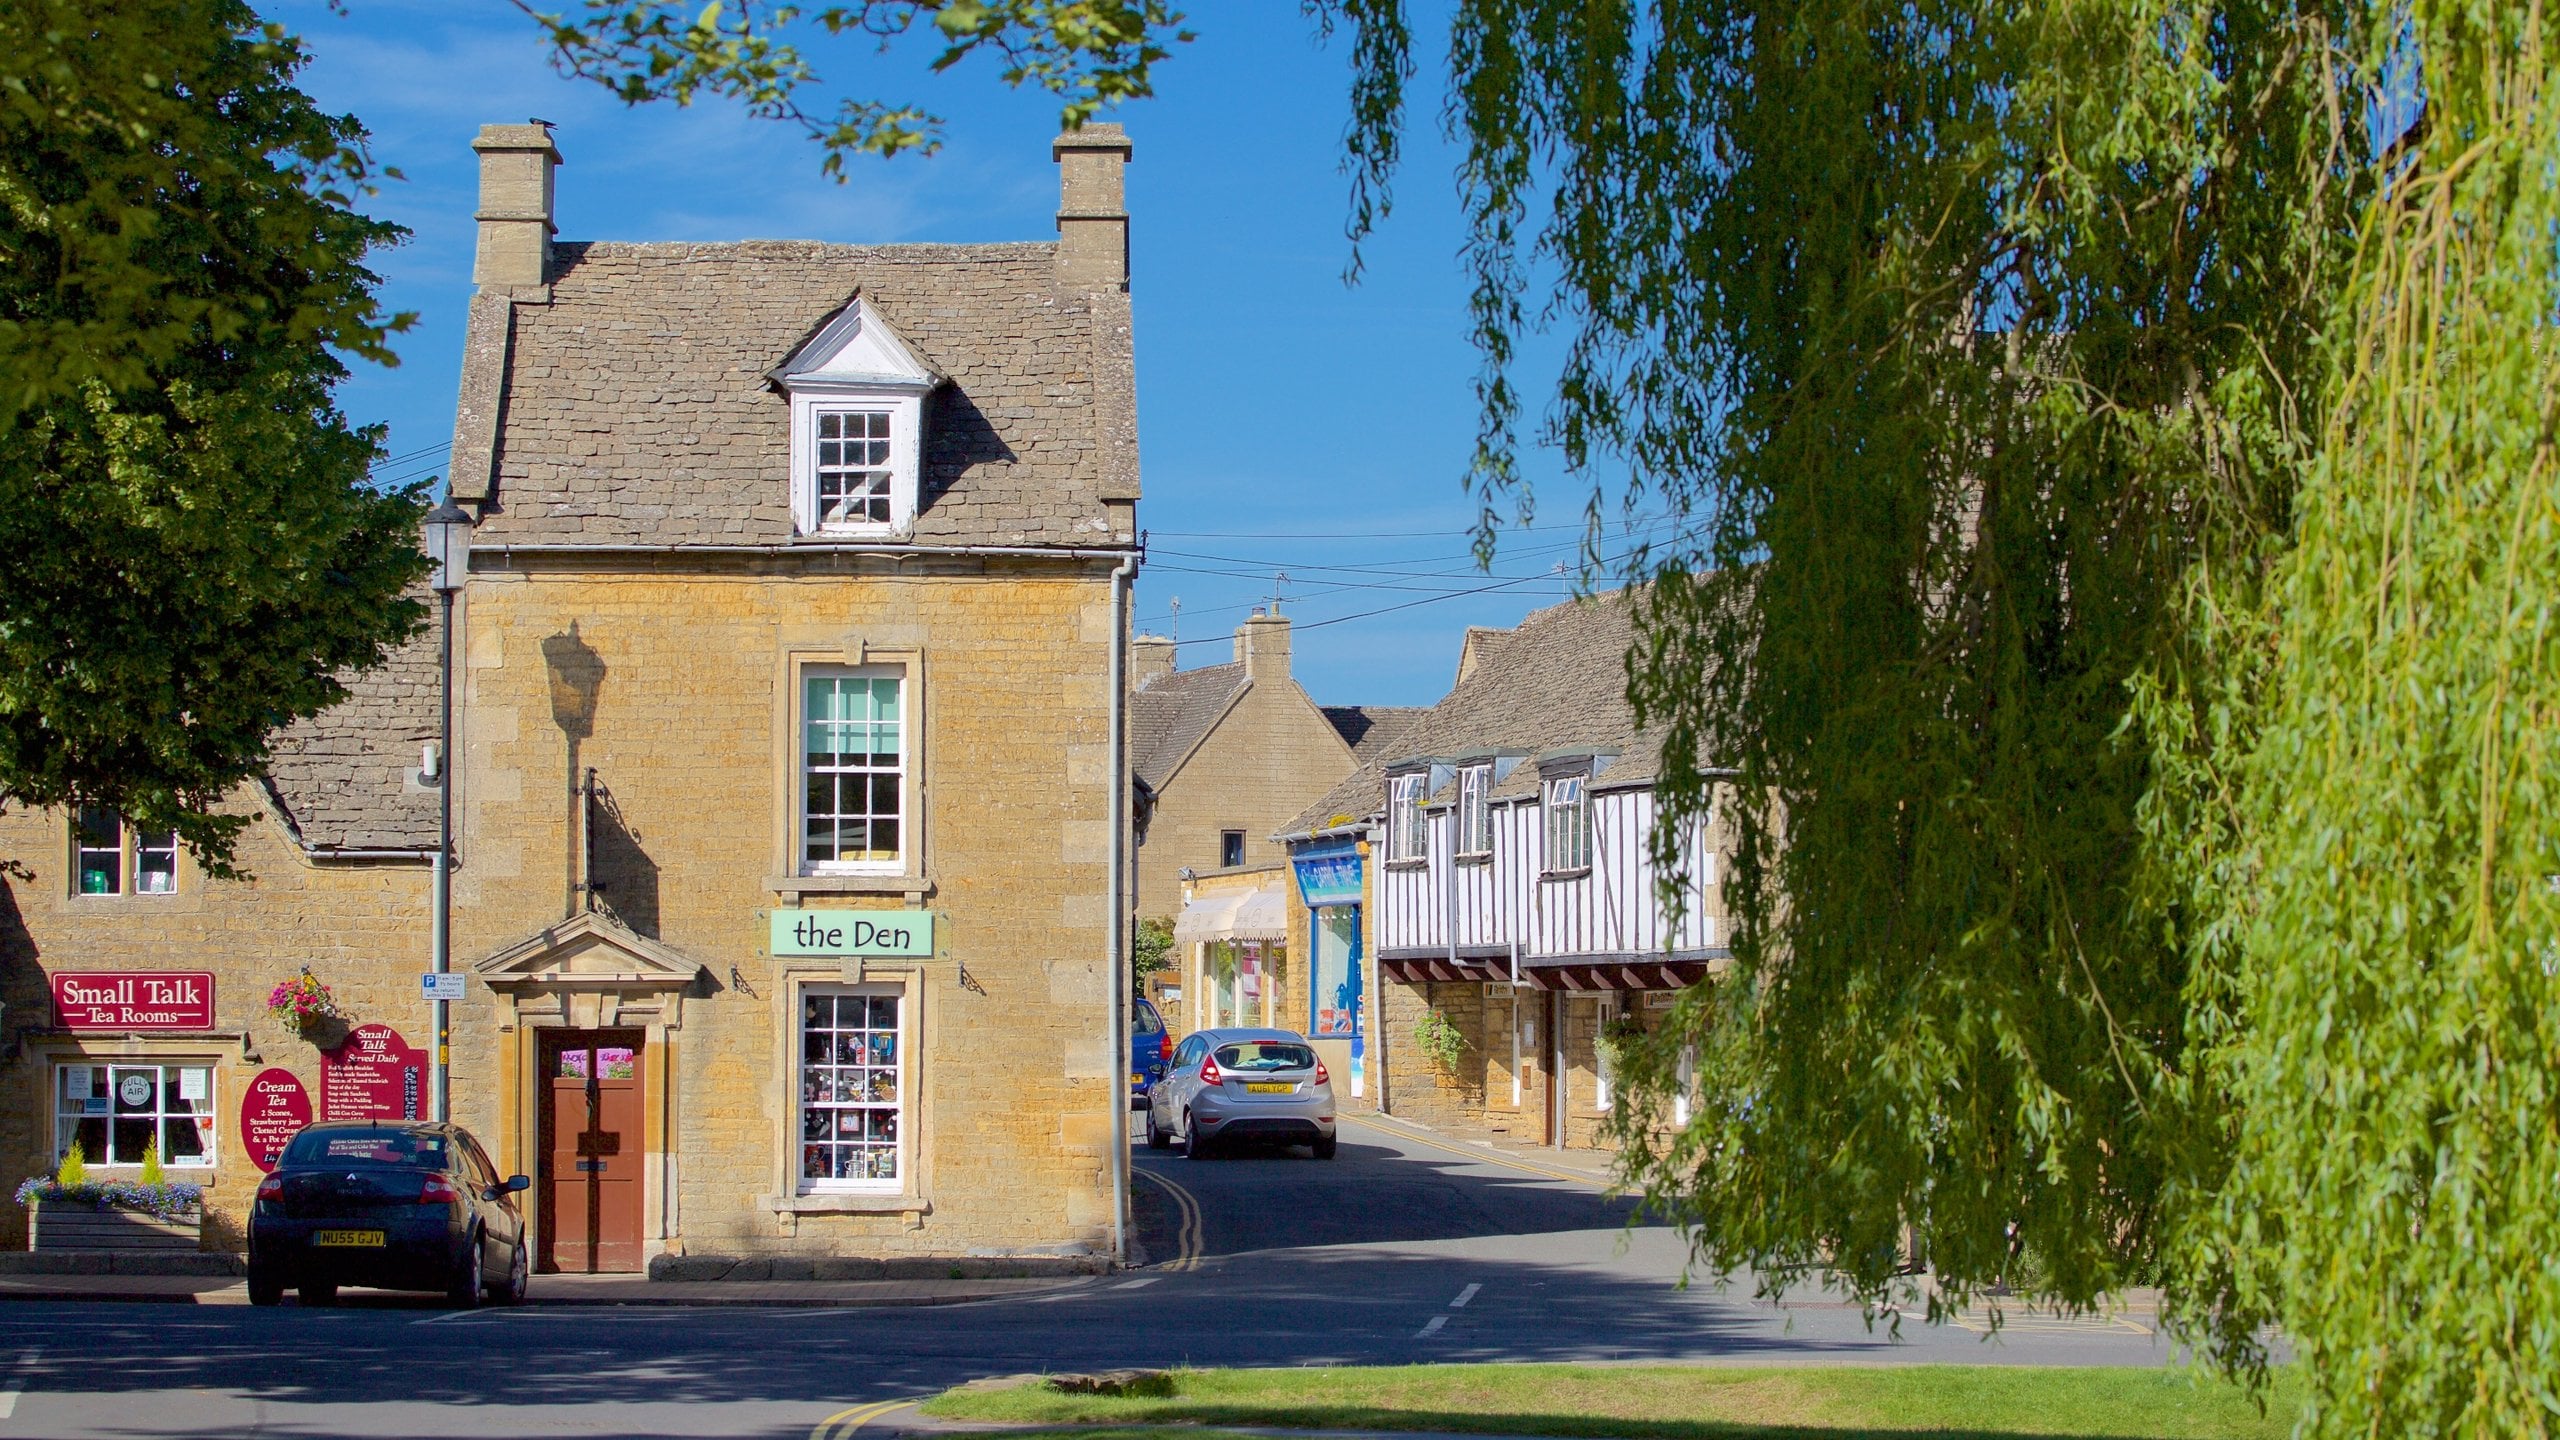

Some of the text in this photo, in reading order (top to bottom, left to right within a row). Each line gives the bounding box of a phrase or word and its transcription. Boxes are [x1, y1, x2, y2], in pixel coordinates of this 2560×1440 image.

[793, 915, 911, 950] the Den
[426, 976, 435, 987] P
[63, 979, 201, 1005] Small Talk
[87, 1007, 178, 1023] Tea Rooms
[357, 1029, 392, 1039] Small
[360, 1040, 387, 1050] Talk
[347, 1054, 400, 1063] Served Daily
[128, 1087, 144, 1096] AIR
[257, 1080, 297, 1093] Cream
[267, 1094, 287, 1106] Tea
[267, 1109, 293, 1117] Scones,
[249, 1118, 302, 1126] Strawberry jam
[265, 1144, 275, 1152] for
[322, 1232, 382, 1244] NU55 GJV
